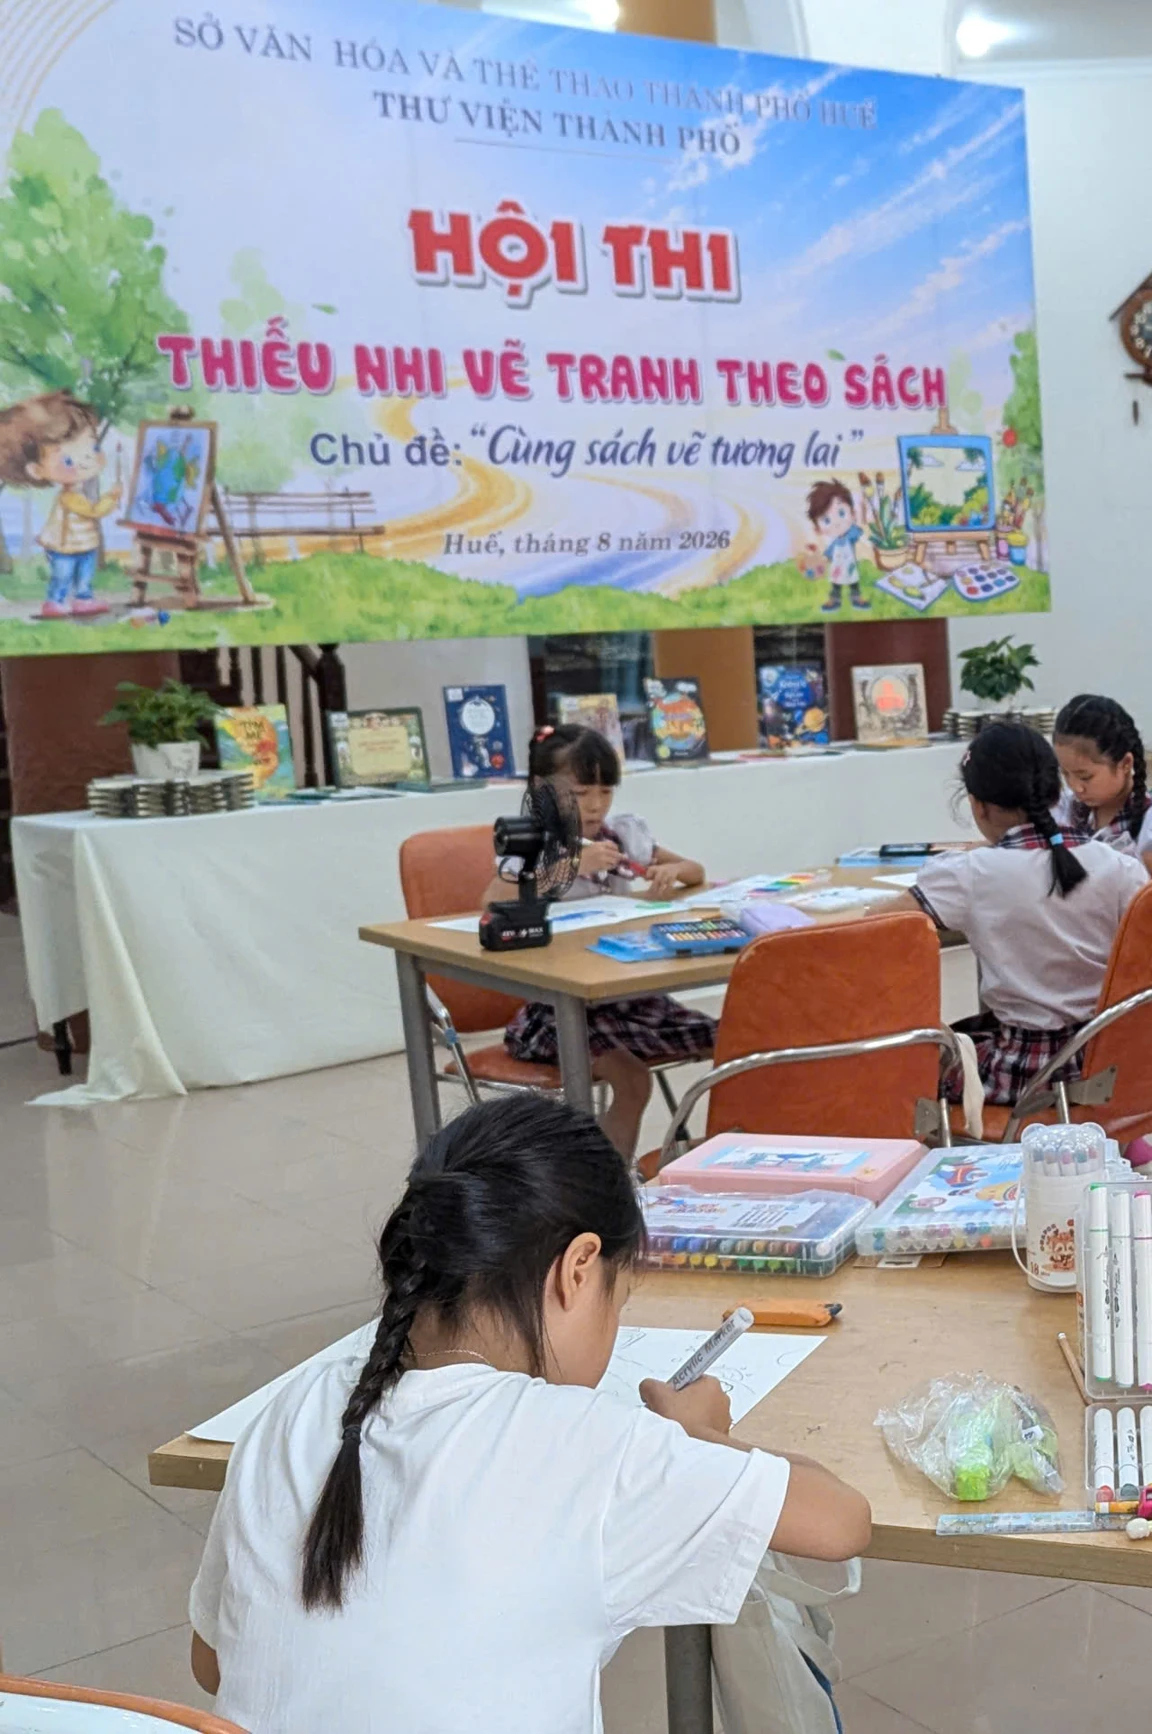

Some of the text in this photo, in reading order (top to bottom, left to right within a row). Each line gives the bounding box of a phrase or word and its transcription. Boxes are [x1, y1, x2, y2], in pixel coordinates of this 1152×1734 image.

[173, 12, 224, 51] SỞ
[234, 23, 313, 62] VĂN
[333, 35, 411, 76] HÓA
[418, 49, 466, 83] VÀ
[471, 54, 541, 93] THỂ
[548, 66, 635, 100] THAO
[642, 78, 745, 116] THÀNH
[819, 94, 879, 131] HUẾ
[373, 90, 741, 155] THƯ VIỆN THÀNH PHỐ
[407, 199, 733, 299] HỘI THI
[156, 317, 947, 409] THIẾU NHI VẼ TRANH THEO SÁCH
[309, 428, 391, 466] Chủ
[403, 426, 463, 467] đề:
[584, 427, 656, 467] sách
[667, 429, 707, 467] vẽ
[709, 433, 794, 479] tương
[442, 528, 731, 557] Huế, tháng 8 năm 2026
[672, 1319, 736, 1389] Acrylic Marker
